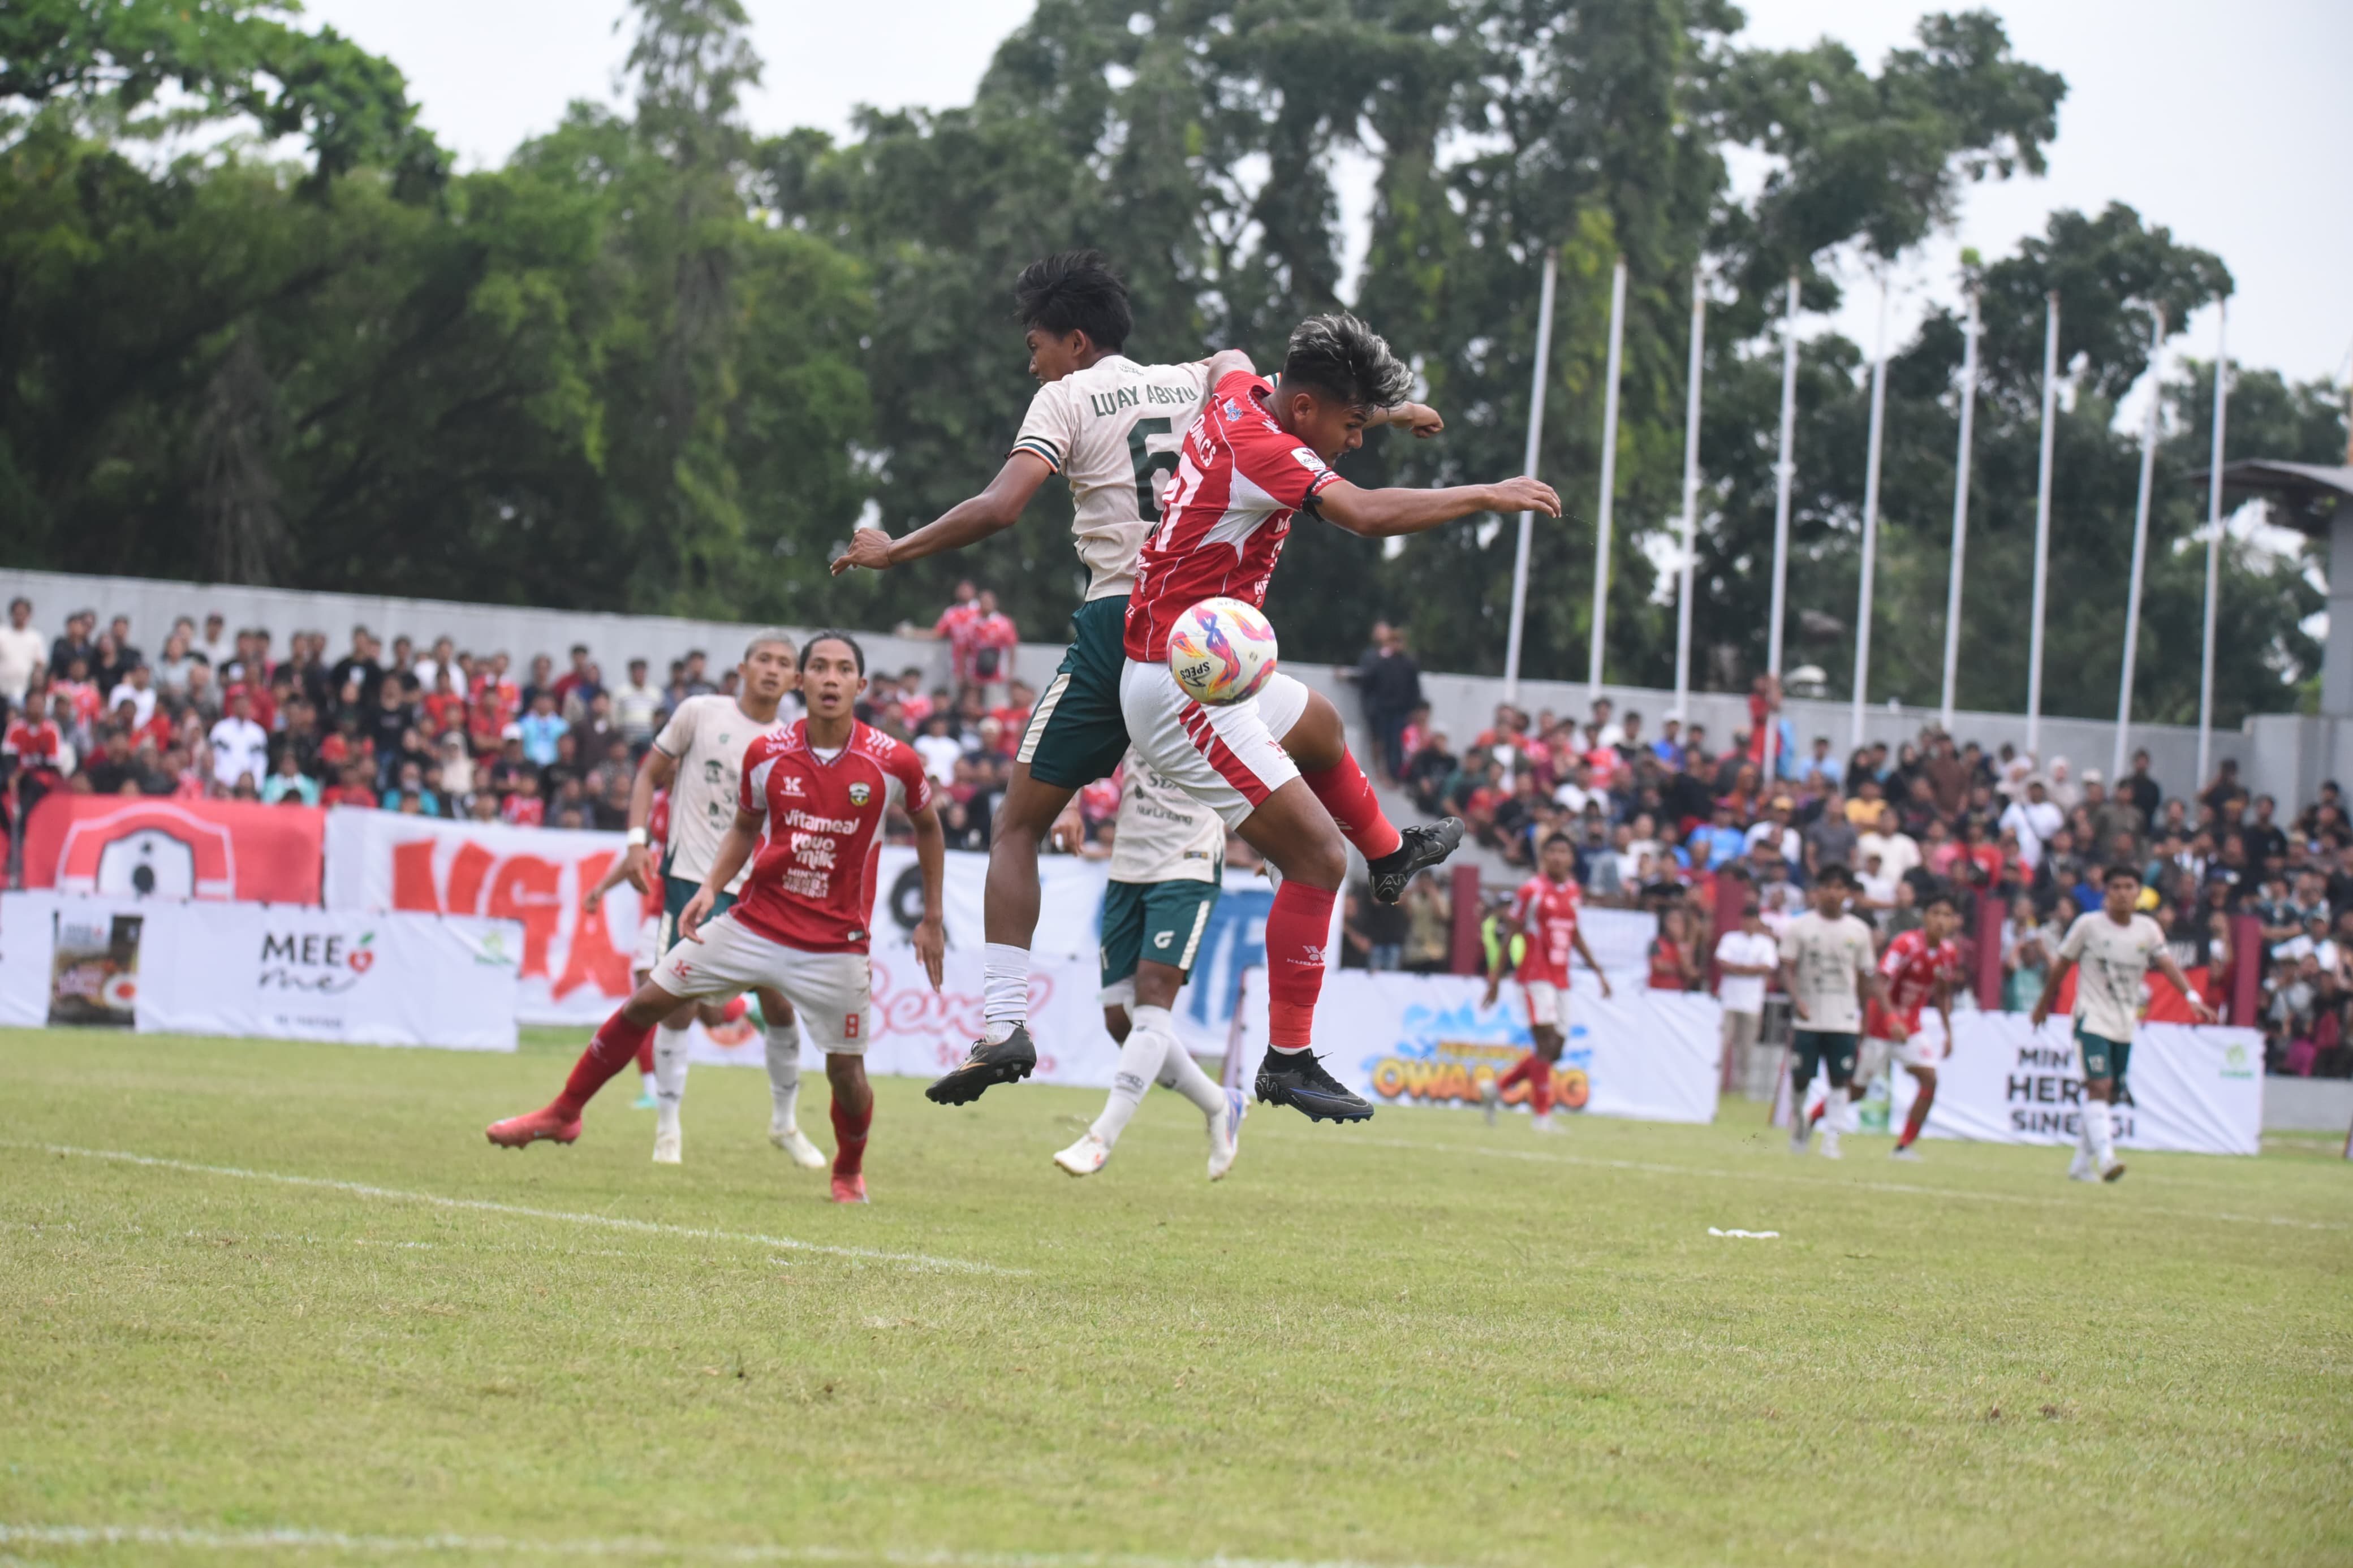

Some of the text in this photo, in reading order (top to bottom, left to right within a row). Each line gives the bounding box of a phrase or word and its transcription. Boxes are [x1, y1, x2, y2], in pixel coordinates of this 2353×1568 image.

[1147, 384, 1199, 404] ABIYU
[1127, 417, 1180, 522] 6
[1180, 662, 1210, 680] SPECS
[261, 932, 343, 966] MEE
[844, 1014, 860, 1038] 8
